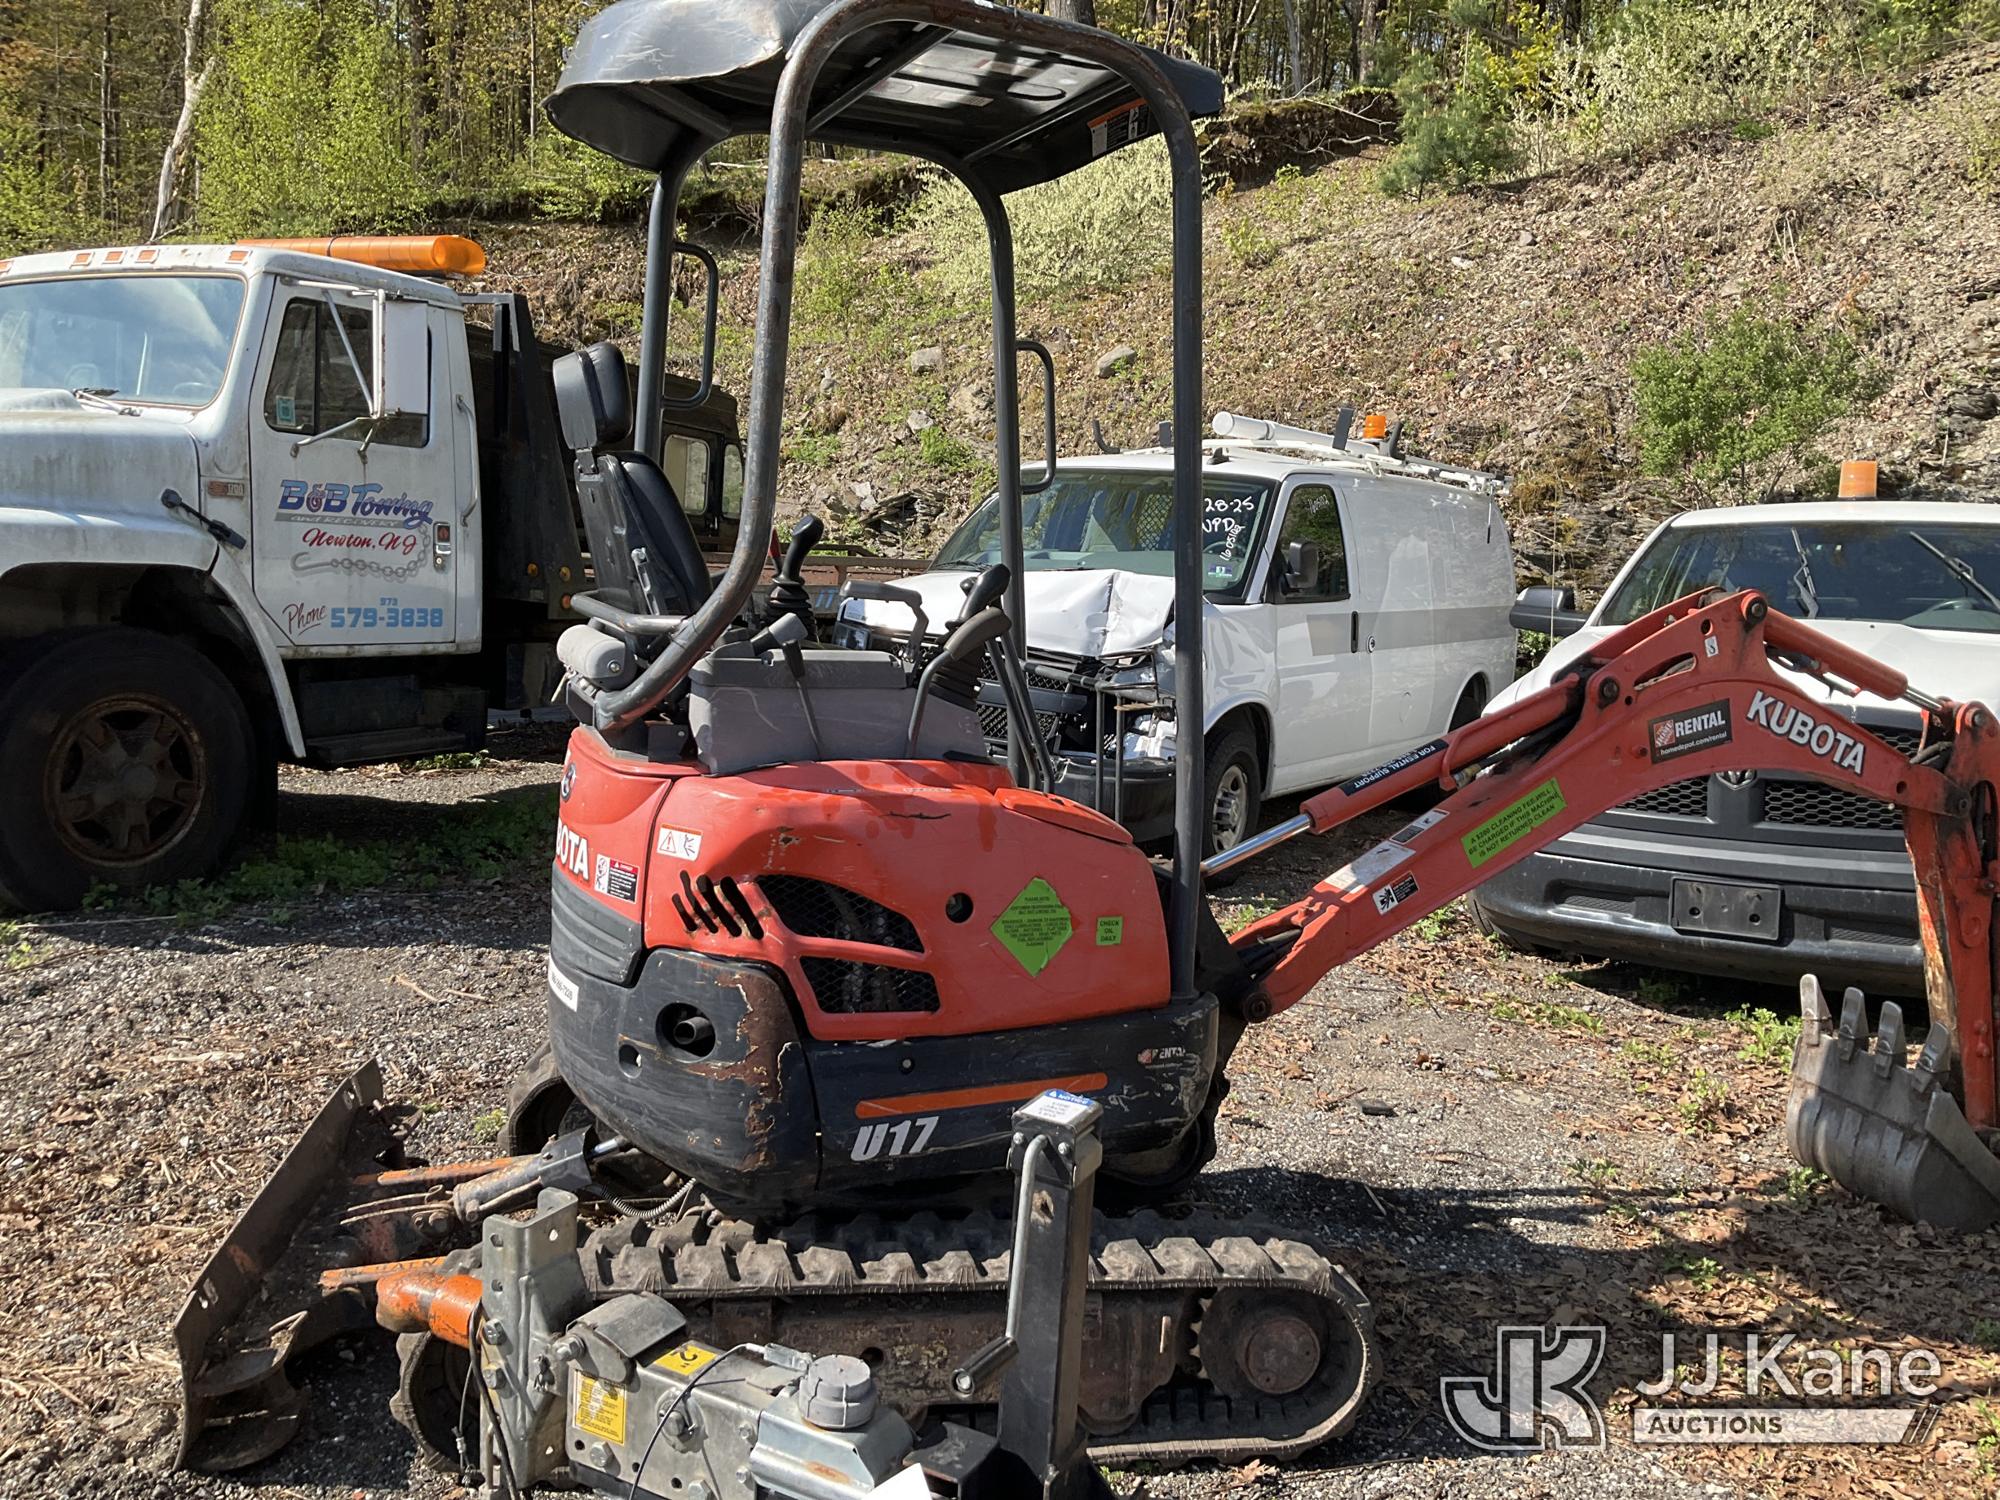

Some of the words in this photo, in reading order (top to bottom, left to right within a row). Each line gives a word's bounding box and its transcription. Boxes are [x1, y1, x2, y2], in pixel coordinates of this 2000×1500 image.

[278, 479, 350, 513] B&B
[351, 482, 434, 530] Towing
[378, 532, 417, 556] NJ
[380, 597, 398, 606] 973
[282, 603, 327, 635] Phone
[330, 607, 443, 628] 579-3838
[1675, 710, 1726, 738] RENTAL
[1747, 690, 1865, 776] KUBOTA
[1418, 745, 1436, 756] FOR
[1660, 731, 1727, 756] homedepot.com/rental
[1354, 767, 1390, 788] SUPPORT
[1478, 824, 1509, 848] CHARGED
[1516, 811, 1531, 822] THIS
[1530, 791, 1560, 812] MACHINE
[1486, 841, 1498, 853] NOT
[1500, 818, 1534, 844] RETURNED
[1533, 804, 1555, 820] CLEAN
[1491, 807, 1522, 829] CLEANING
[1522, 798, 1535, 809] FEE
[851, 1116, 939, 1161] U17
